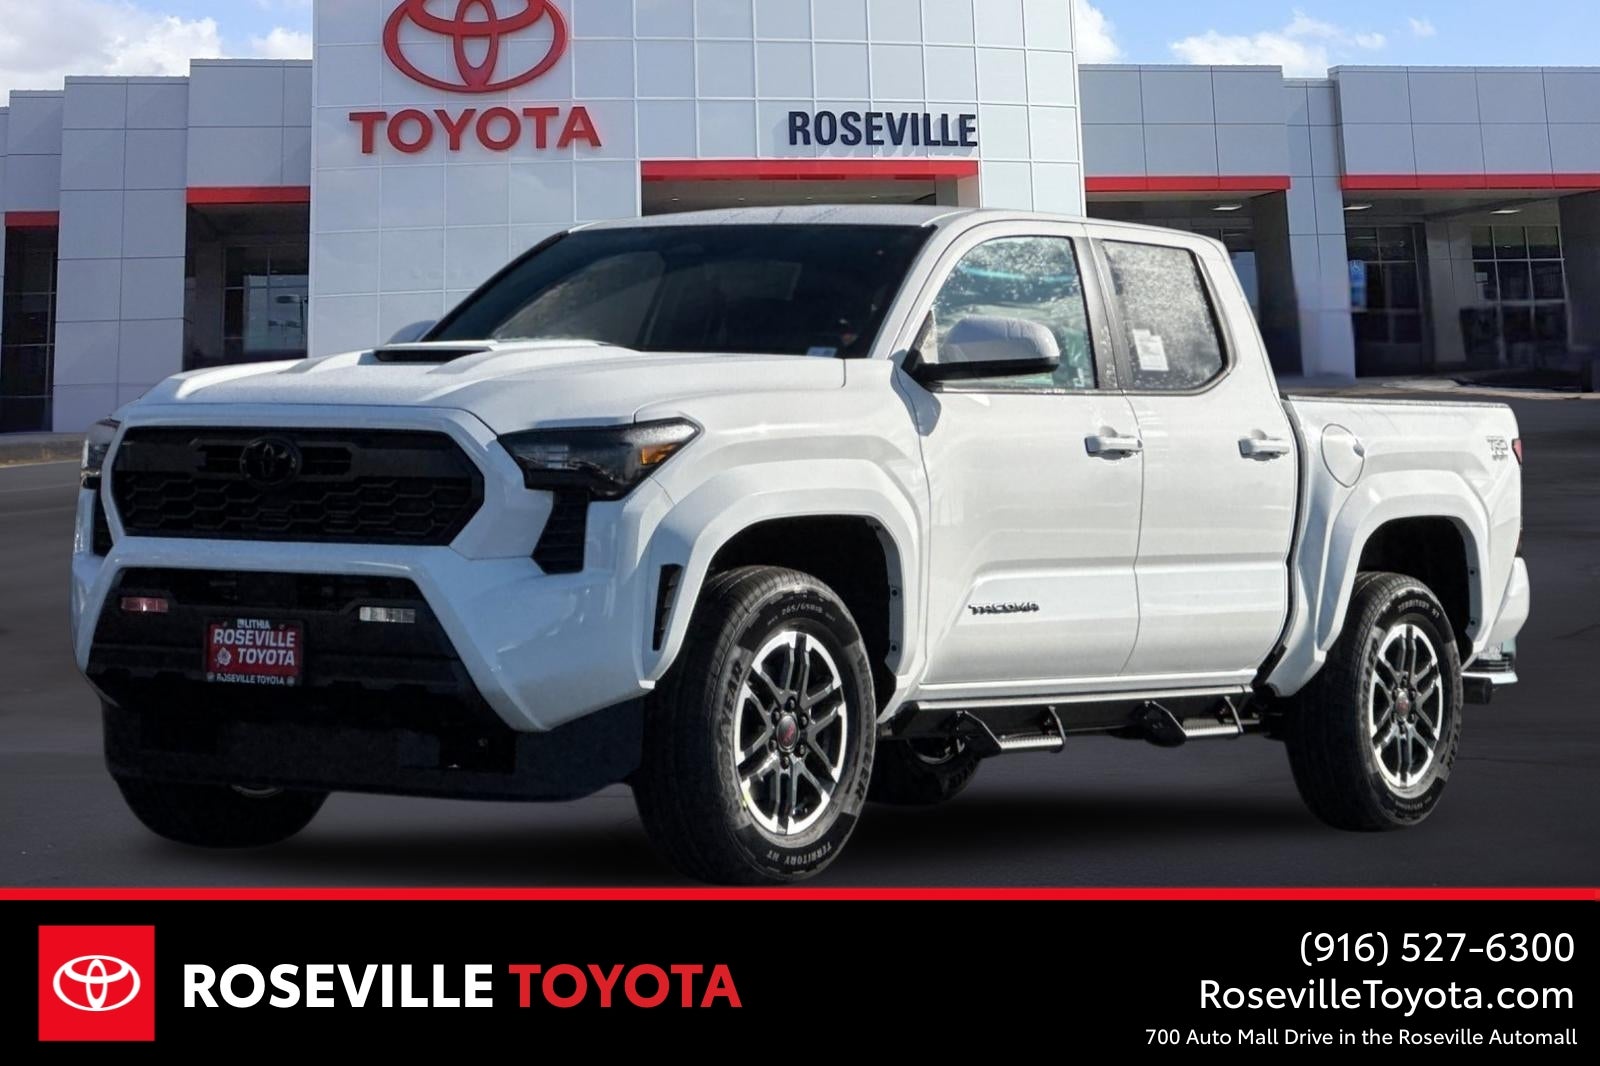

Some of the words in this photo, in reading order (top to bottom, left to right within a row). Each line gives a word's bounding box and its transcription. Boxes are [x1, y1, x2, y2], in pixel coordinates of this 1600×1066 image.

[349, 106, 602, 153] TOYOTA
[788, 111, 978, 147] ROSEVILLE
[968, 602, 1040, 615] TACOMA
[213, 629, 295, 647] ROSEVILLE
[238, 648, 295, 666] TOYOTA
[216, 673, 255, 683] ROSEVILLE
[257, 675, 284, 685] TOYOTA
[784, 840, 832, 866] TERRITORY
